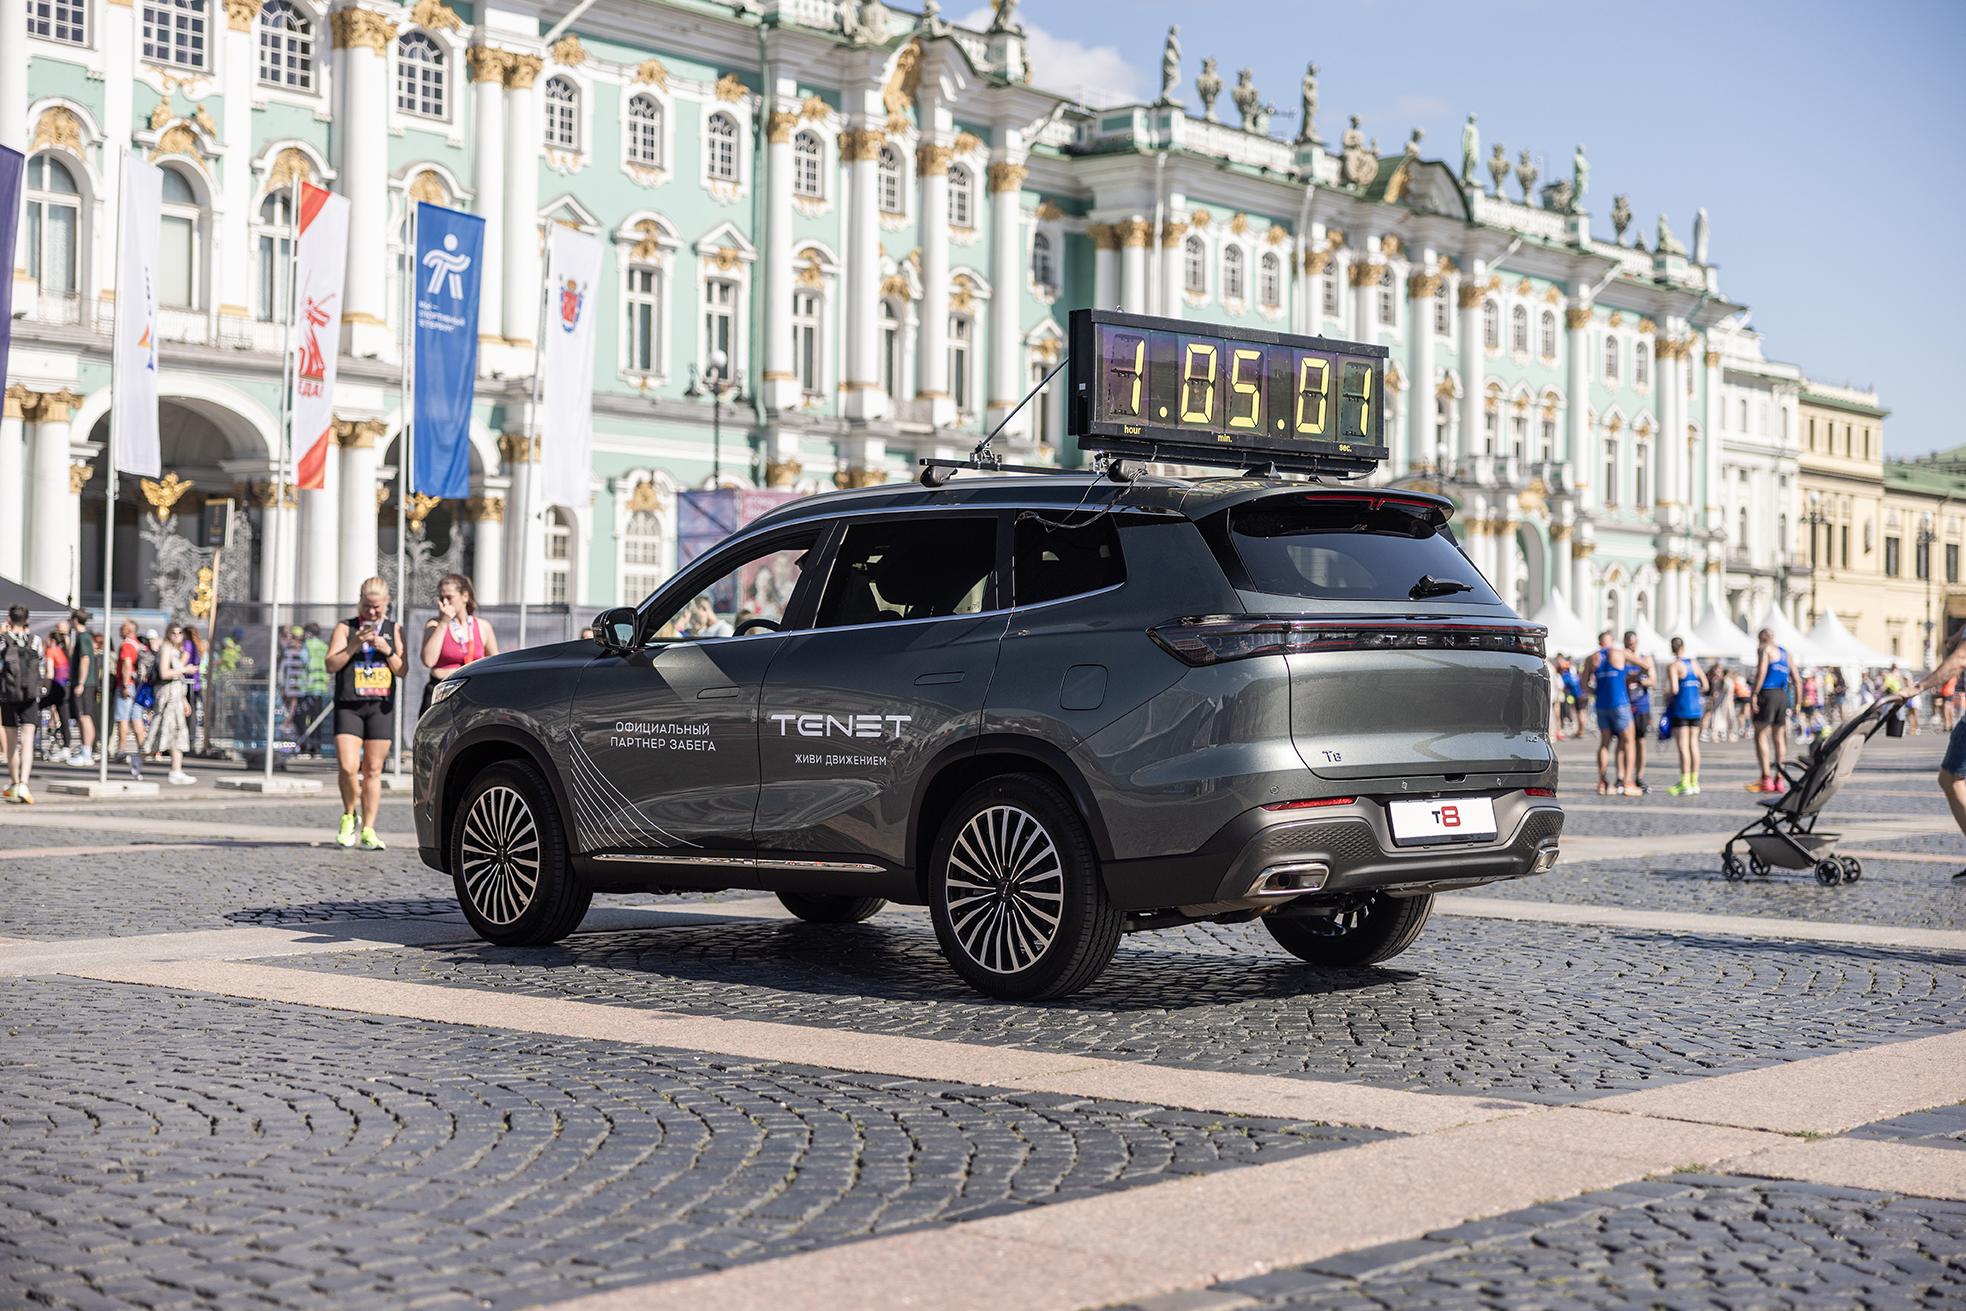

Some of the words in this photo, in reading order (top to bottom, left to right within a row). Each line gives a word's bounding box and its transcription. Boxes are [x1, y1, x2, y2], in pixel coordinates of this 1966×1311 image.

[1124, 424, 1142, 436] hour
[1217, 433, 1233, 443] min.
[1385, 634, 1503, 647] TENET
[615, 721, 711, 736] ОФИЦИАЛЬНЫЙ
[771, 714, 912, 738] TENET
[610, 737, 666, 750] ПАРТНЕР
[669, 739, 716, 751] ЗАБЕГА
[795, 754, 822, 766] ЖИВИ
[825, 755, 887, 767] ДВИЖЕНИЕМ
[1431, 806, 1461, 828] T8
